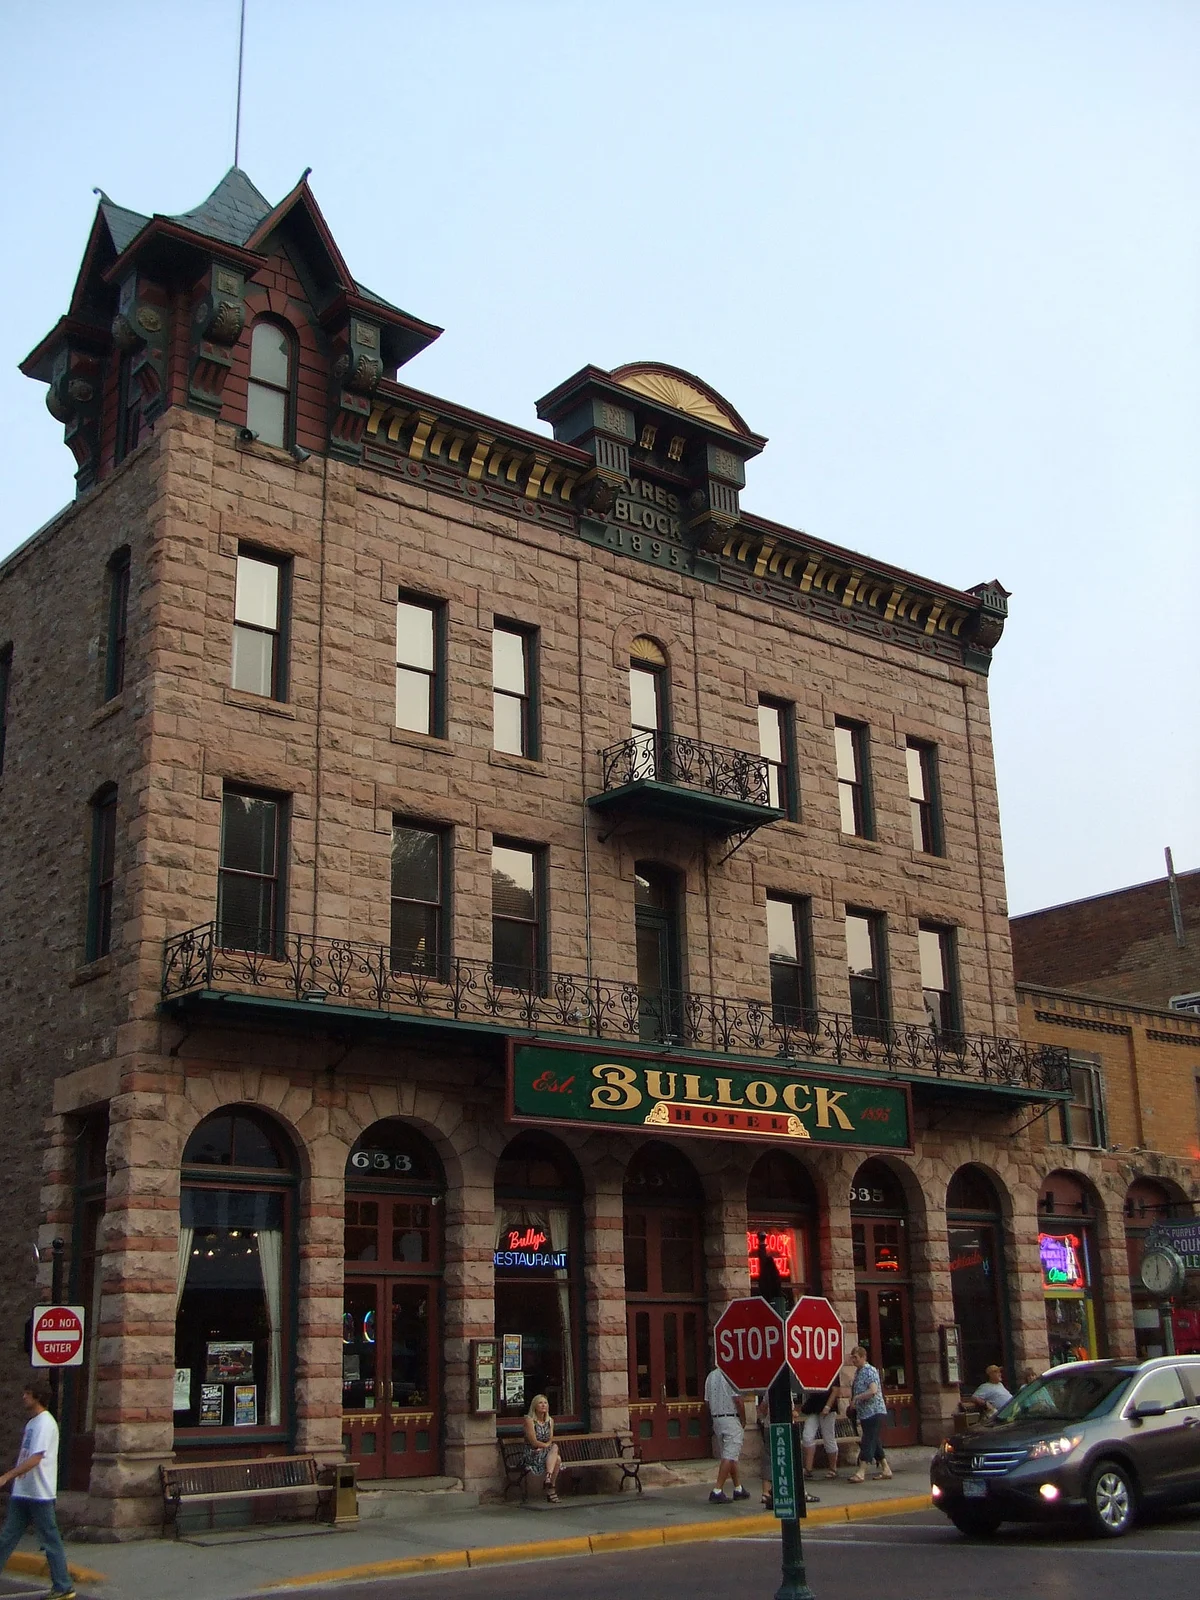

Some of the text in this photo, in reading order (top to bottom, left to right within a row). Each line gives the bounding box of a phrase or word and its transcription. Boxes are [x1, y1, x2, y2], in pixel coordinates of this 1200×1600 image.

[615, 499, 682, 541] BLOCK
[531, 1069, 573, 1095] Est.
[589, 1063, 856, 1131] BULLOCK
[674, 1108, 784, 1129] HOTEL
[860, 1106, 893, 1122] 1895
[351, 1150, 413, 1172] 633
[848, 1187, 885, 1202] 635
[508, 1227, 547, 1251] Bullys
[746, 1231, 791, 1257] BULOCK
[748, 1257, 790, 1276] HEL
[42, 1317, 76, 1329] DO NOT
[43, 1343, 72, 1354] ENTER
[719, 1326, 780, 1362] STOP
[790, 1325, 840, 1361] STOP
[775, 1426, 789, 1496] PARKING
[775, 1498, 793, 1506] RAMP
